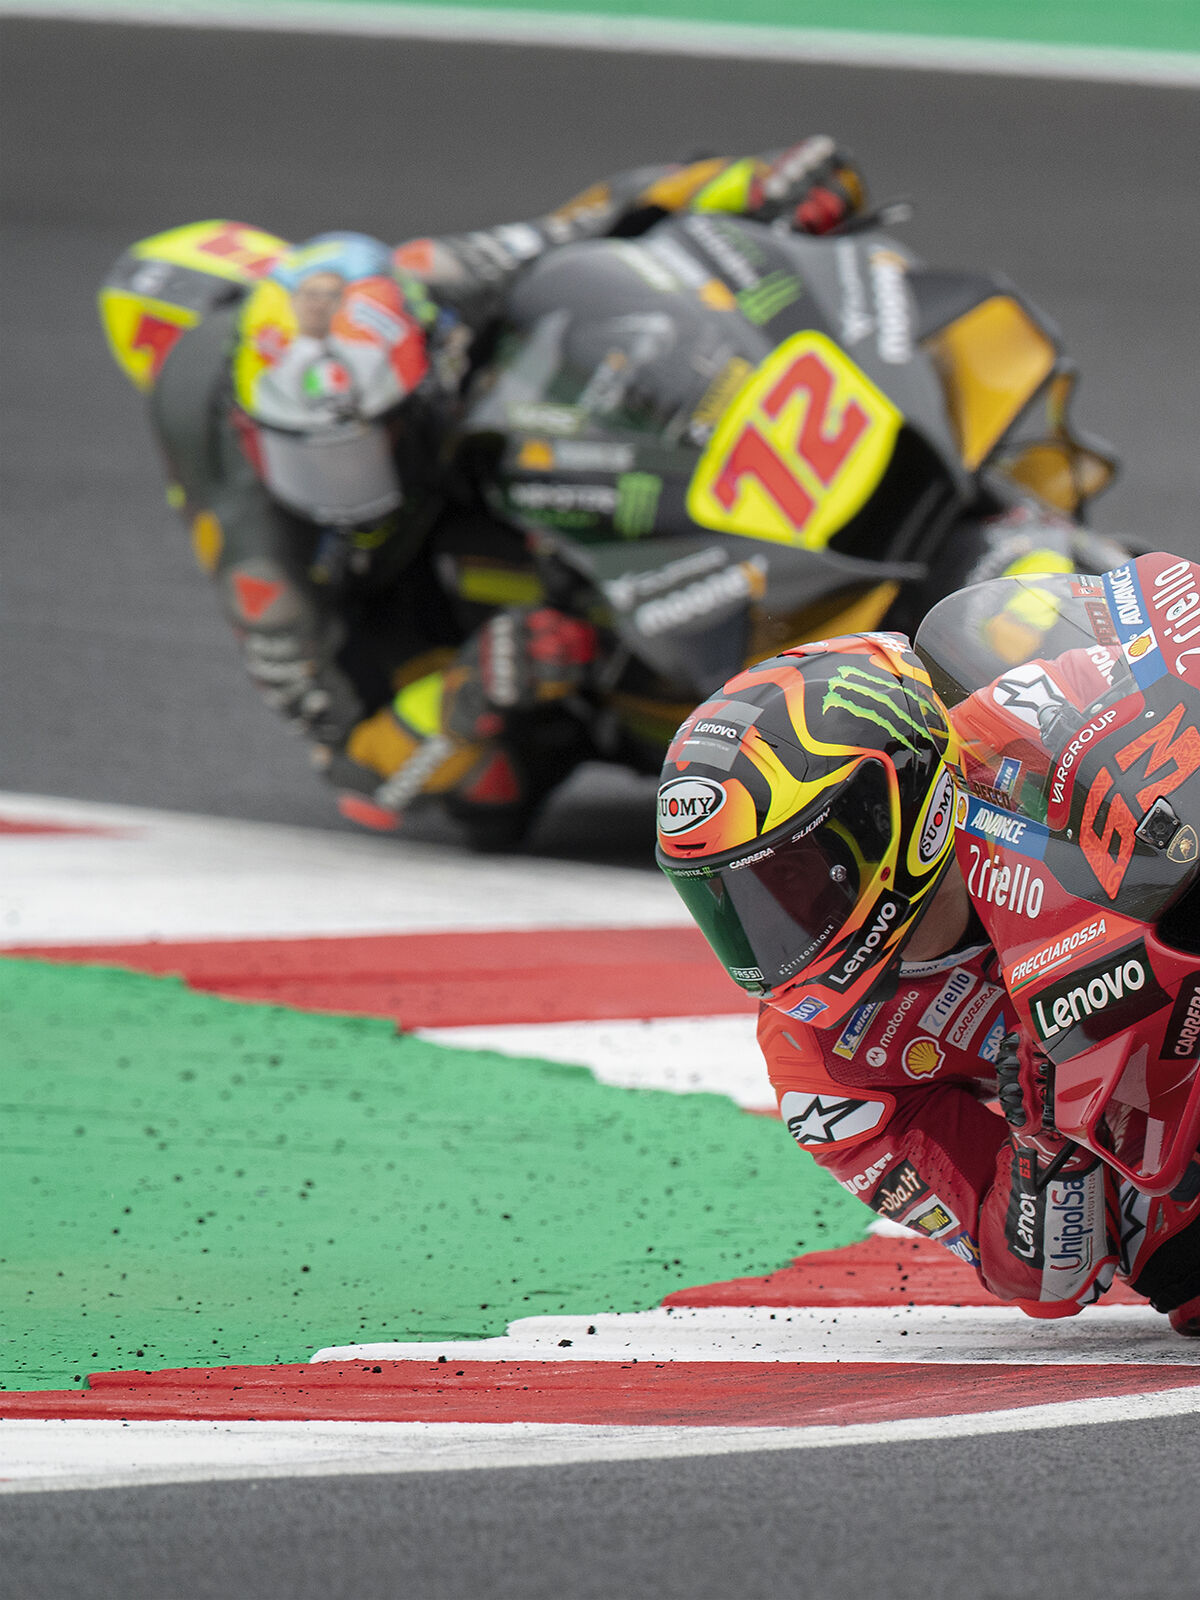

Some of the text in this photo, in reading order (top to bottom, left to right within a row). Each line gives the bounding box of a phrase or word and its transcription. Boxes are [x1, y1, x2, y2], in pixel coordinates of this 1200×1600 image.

[712, 350, 870, 533] 72
[1108, 566, 1143, 625] ADVANCE
[694, 721, 737, 739] Lenovo
[1051, 709, 1117, 804] VARGROUP
[660, 797, 713, 817] UOMY
[921, 776, 954, 855] SUOMY
[970, 807, 1027, 845] ADVANCE
[728, 847, 776, 870] CARRERA
[977, 855, 1044, 919] riello
[828, 902, 897, 985] Lenovo
[1010, 918, 1107, 985] FRECCIAROSSA
[879, 990, 920, 1049] motorola
[935, 972, 970, 1016] riello
[952, 986, 997, 1044] CARRERA
[1034, 958, 1147, 1041] Lenovo
[842, 1152, 894, 1195] UCAT
[1050, 1176, 1094, 1271] UnipolSa
